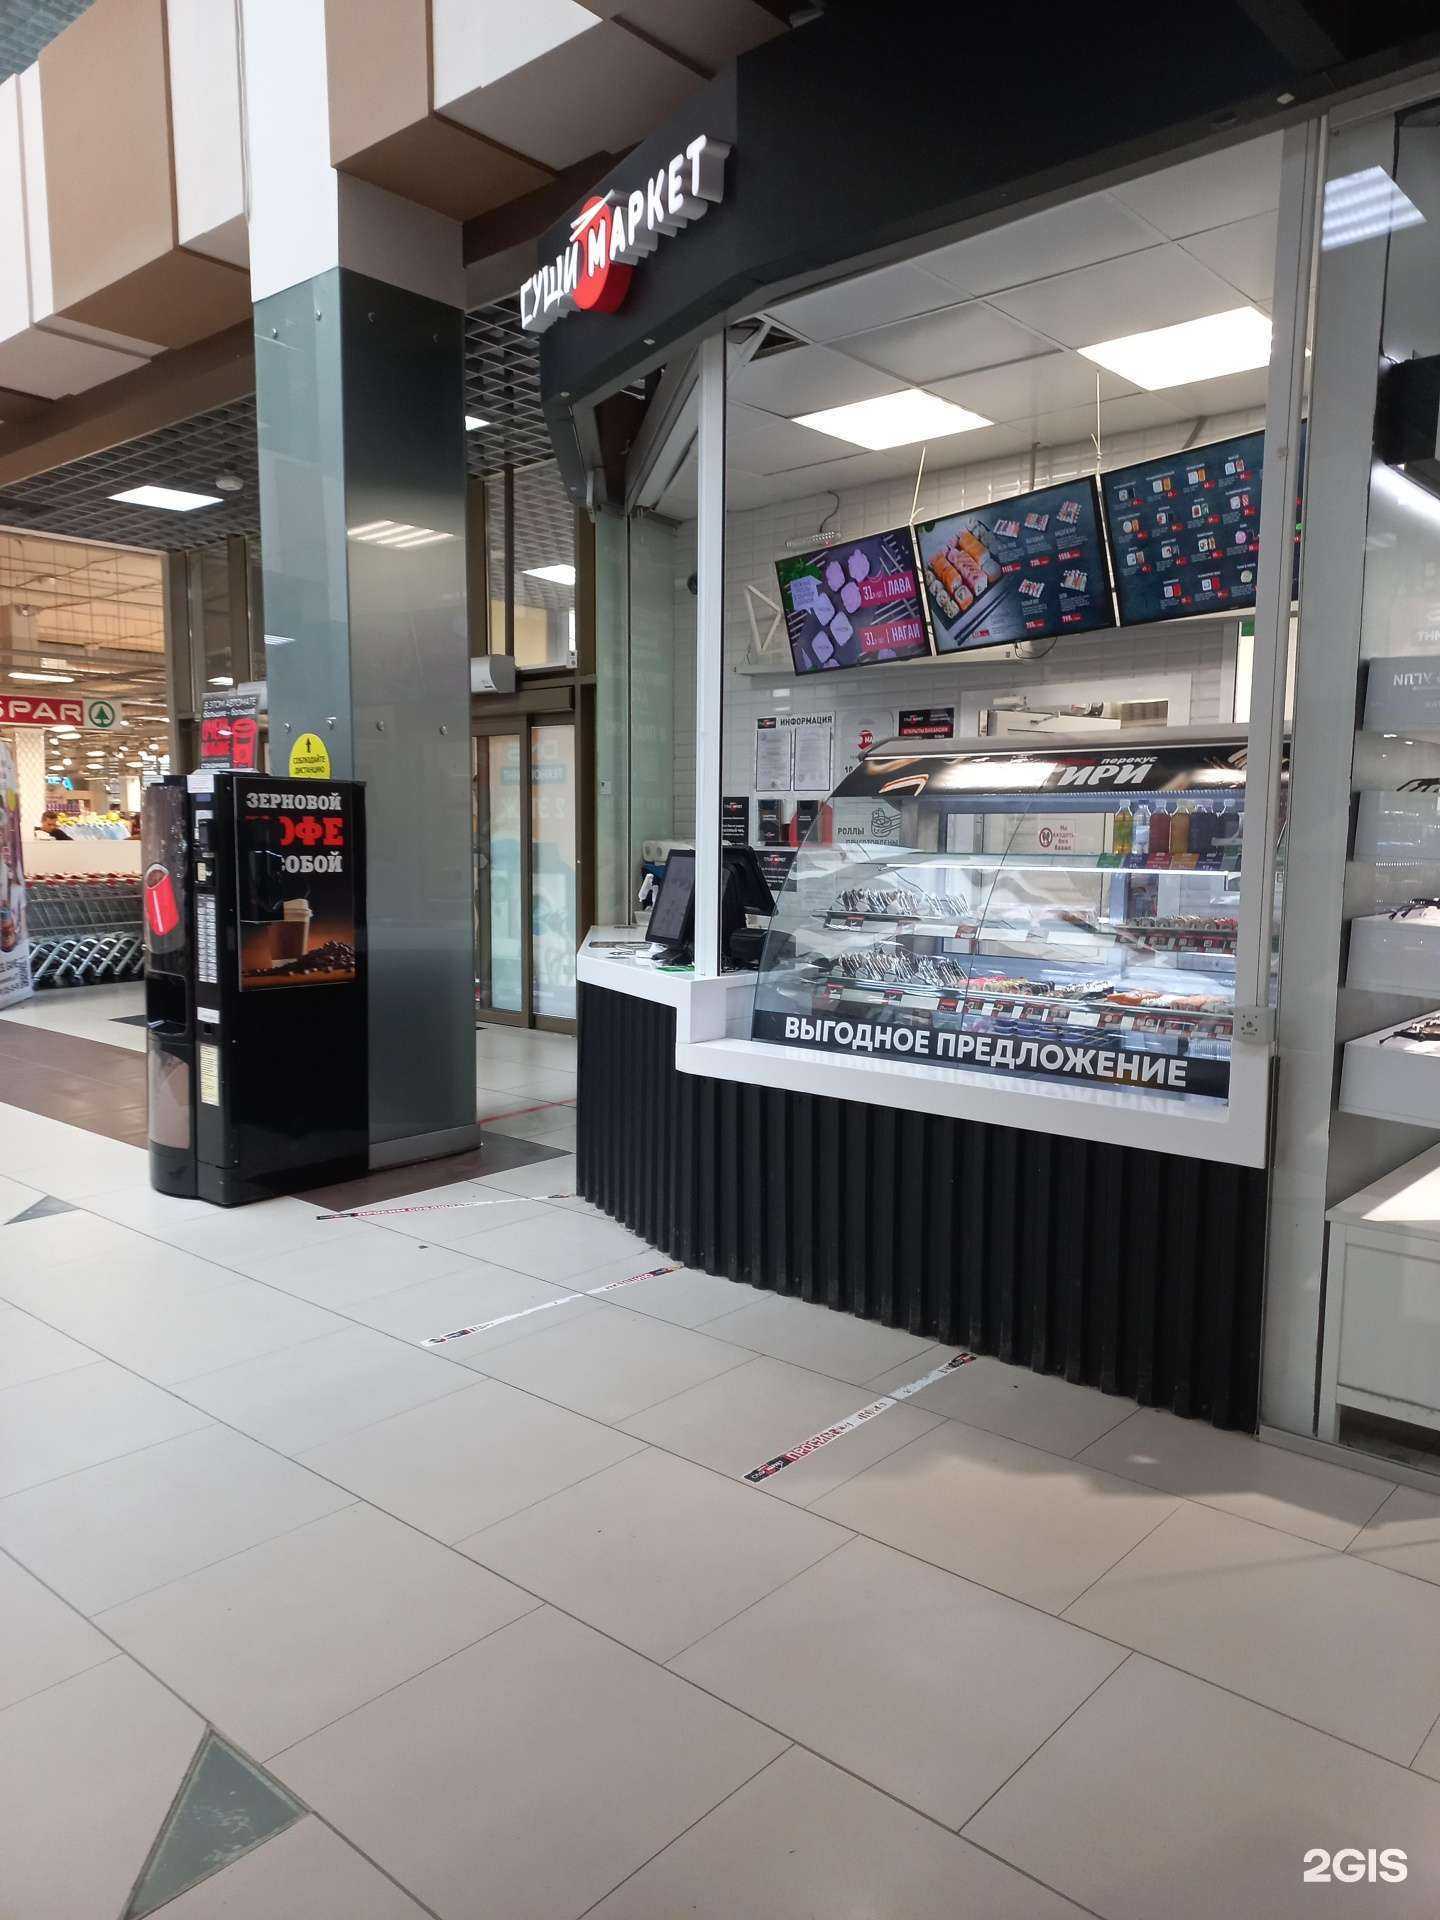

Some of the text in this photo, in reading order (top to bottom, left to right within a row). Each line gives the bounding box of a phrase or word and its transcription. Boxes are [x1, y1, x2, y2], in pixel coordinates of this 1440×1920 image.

[520, 134, 707, 330] СУШИ МАРКЕТ
[888, 576, 912, 596] ЛАВА
[0, 700, 82, 722] PAR
[780, 715, 833, 726] ИНФОРМАЦИЯ
[246, 792, 342, 810] ЗЕРНОВОЙ
[279, 816, 345, 846] ОФЕ
[837, 827, 865, 835] РОЛЛЫ
[281, 851, 344, 873] ОБОЙ
[785, 1016, 1188, 1087] ВЫГОДНОЕ ПРЕДЛОЖЕНИЕ
